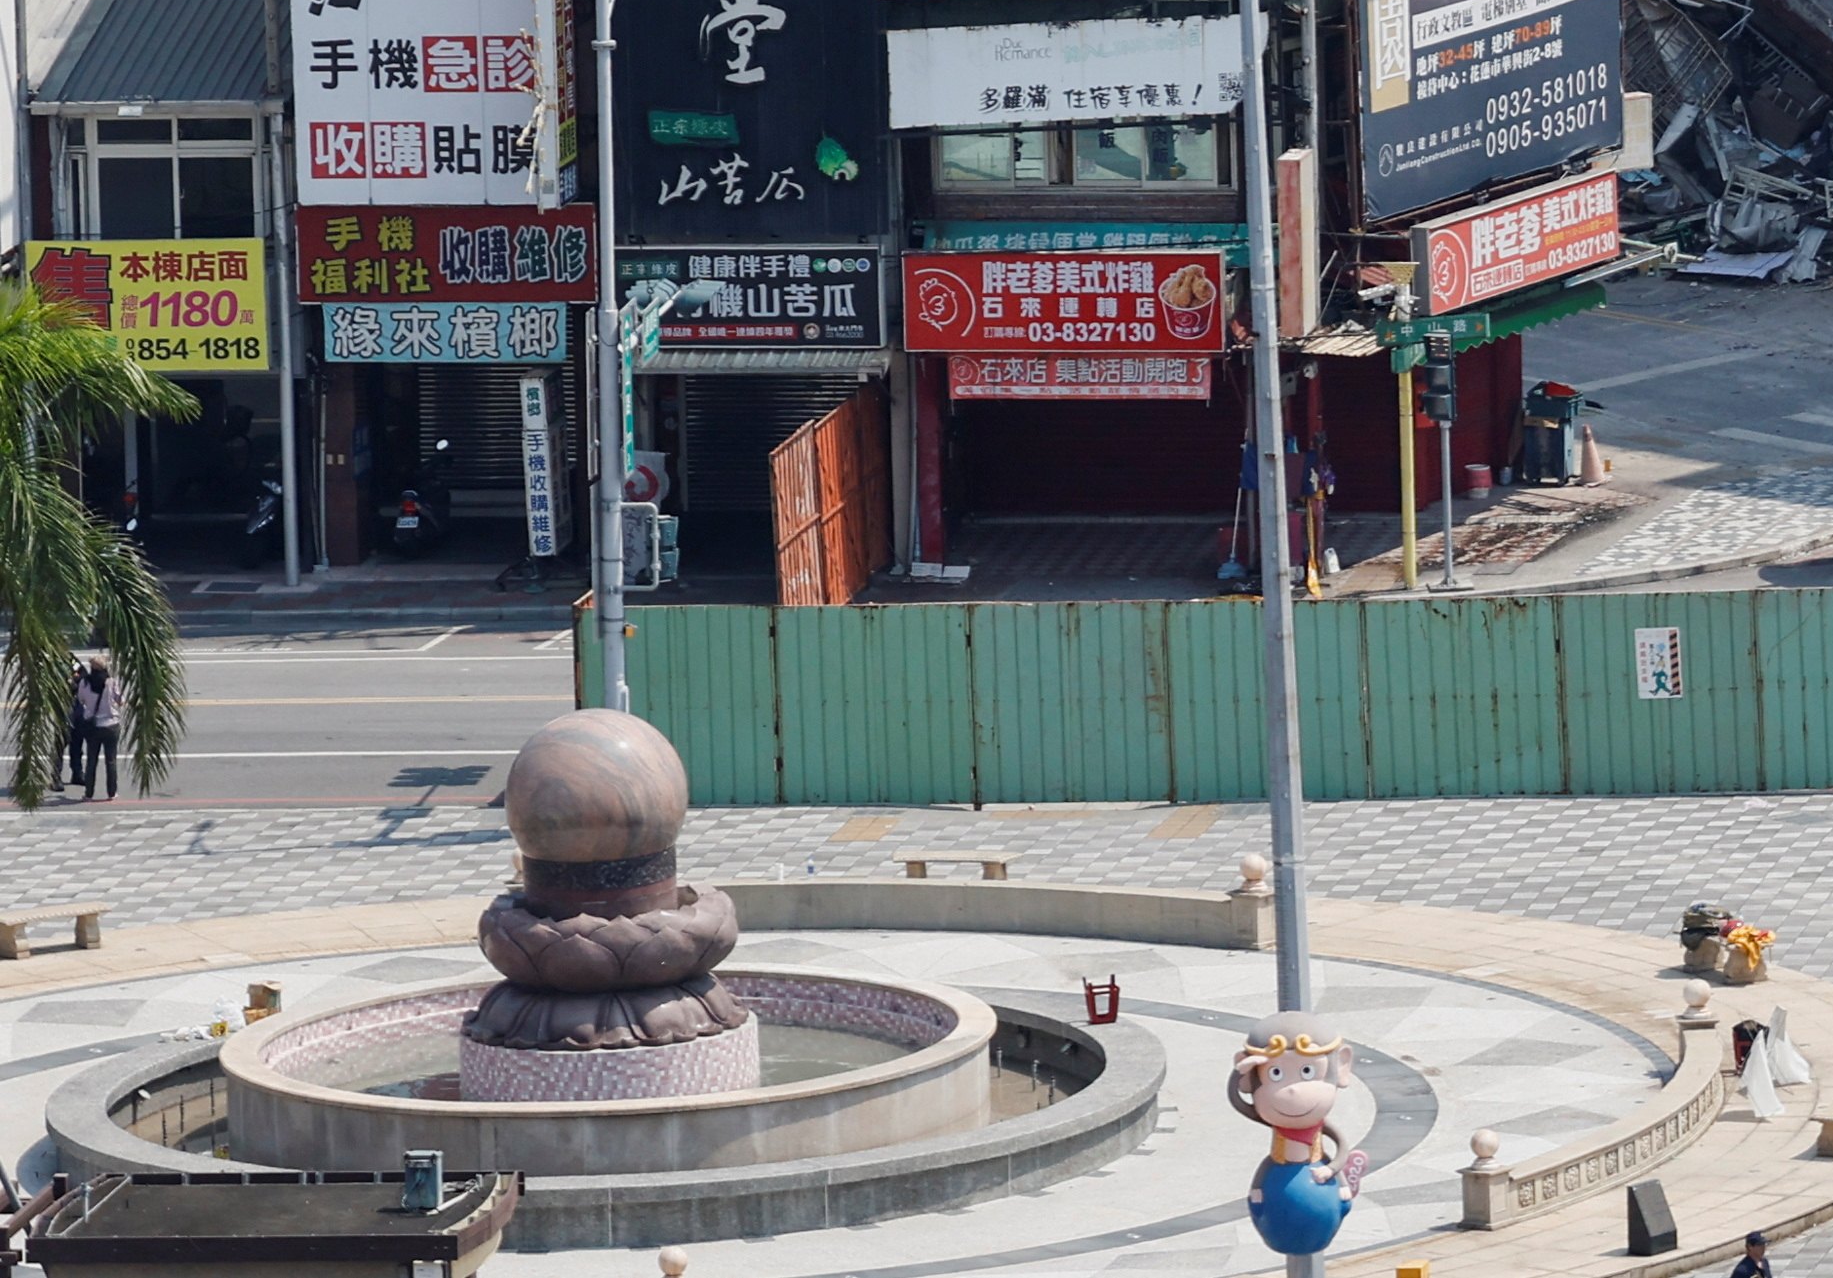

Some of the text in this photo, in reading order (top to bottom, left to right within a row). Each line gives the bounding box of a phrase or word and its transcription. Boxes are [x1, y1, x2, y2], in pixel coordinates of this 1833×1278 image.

[1416, 6, 1474, 42] 行政文教區
[310, 38, 535, 90] 手機急診
[979, 85, 1051, 114] 多羅滿
[1486, 63, 1608, 124] 0932-581018
[1486, 96, 1608, 158] 0905-935071
[314, 123, 538, 176] 收購貼膜
[325, 215, 415, 252] 手機
[1548, 230, 1616, 271] 03-8327130
[119, 250, 249, 283] 本棟店面
[439, 225, 588, 284] 收購維修
[688, 254, 812, 279] 健康伴手禮
[310, 257, 431, 295] 福利社
[981, 260, 1156, 295] 胖老爹美式炸雞
[140, 290, 238, 327] 1180
[239, 309, 255, 325] 萬
[676, 283, 857, 319] 機山苦瓜
[981, 296, 1156, 319] 石來運轉店
[330, 306, 557, 360] 緣來檳榔
[1028, 322, 1156, 343] 03-8327130
[1400, 319, 1468, 337] 中山路
[138, 336, 261, 361] 854-1818
[980, 357, 1210, 384] 石來店 集點活動開跑了
[524, 433, 553, 553] 手機收購維修
